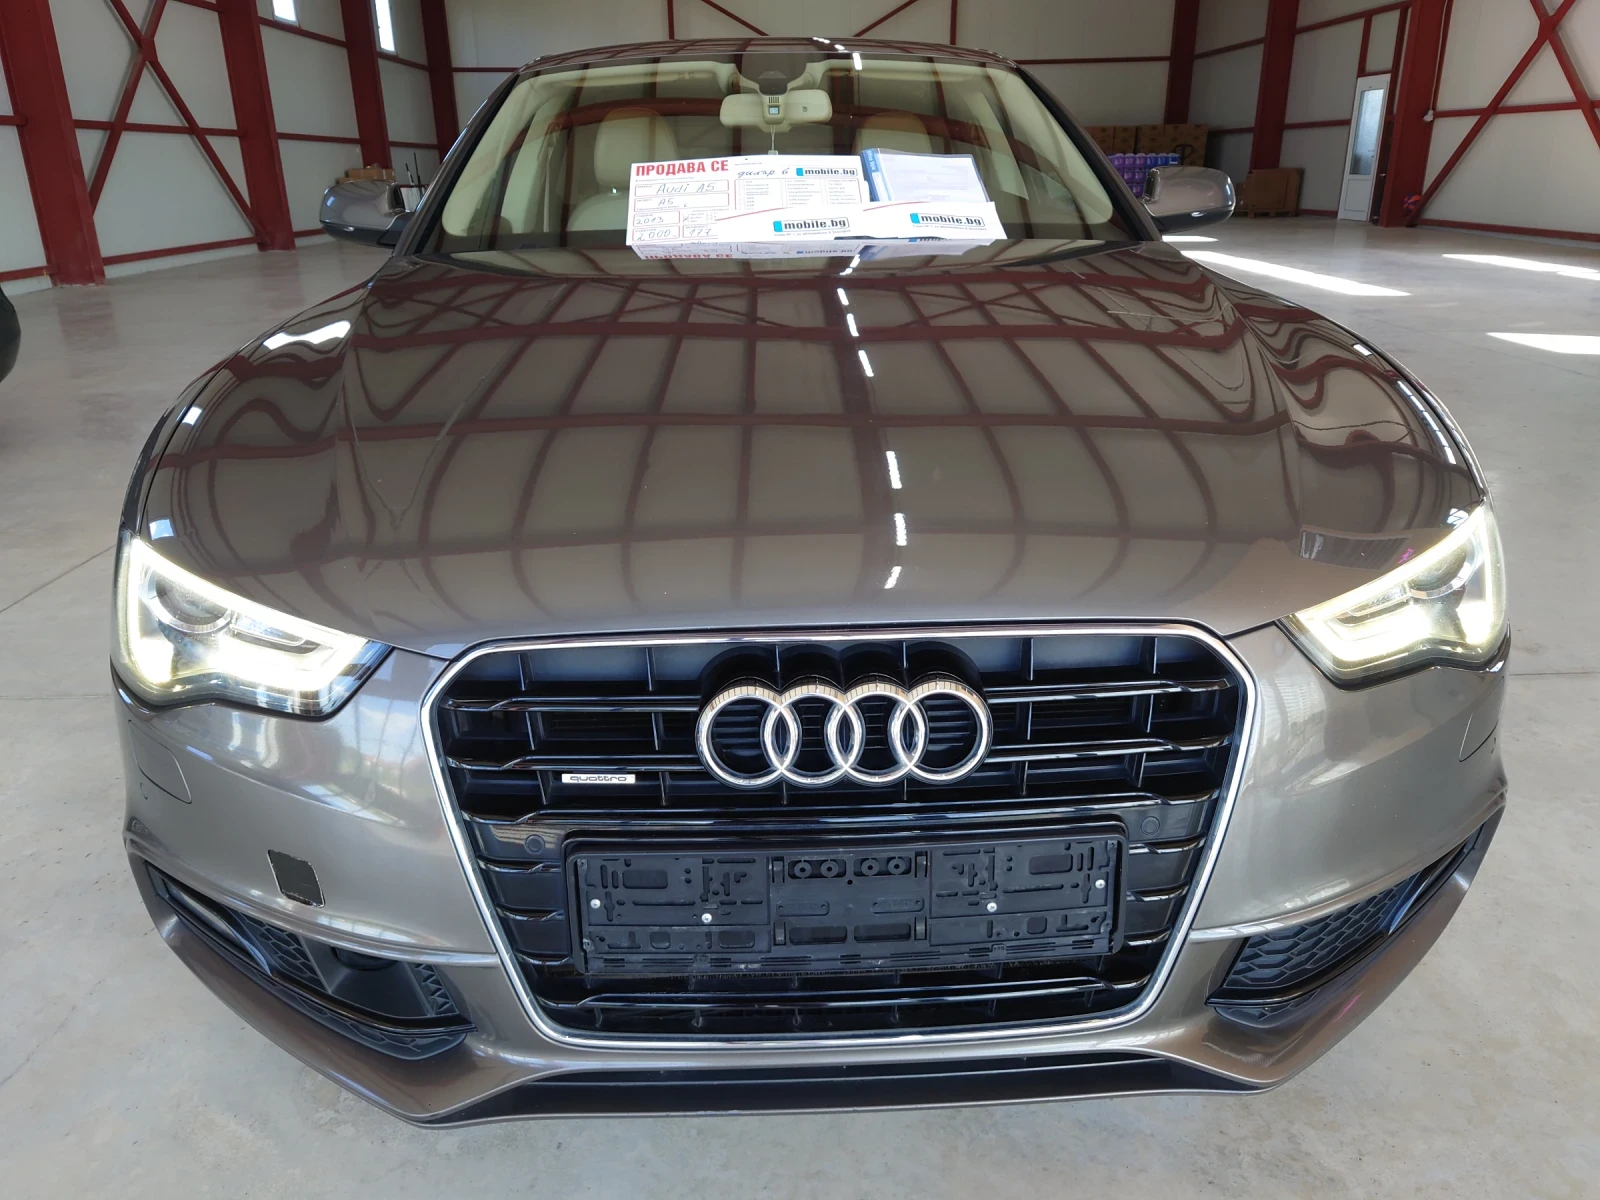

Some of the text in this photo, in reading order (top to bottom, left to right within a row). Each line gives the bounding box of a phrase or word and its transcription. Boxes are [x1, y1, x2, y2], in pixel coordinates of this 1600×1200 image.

[636, 160, 729, 176] ПРОДАВА СЕ
[804, 168, 856, 176] mobile.bg
[656, 182, 717, 194] Audi A5
[636, 216, 664, 225] 2013
[784, 219, 846, 230] mobile.bg
[921, 215, 982, 226] mobile.bg
[689, 228, 712, 236] 177
[569, 775, 627, 783] quattro
